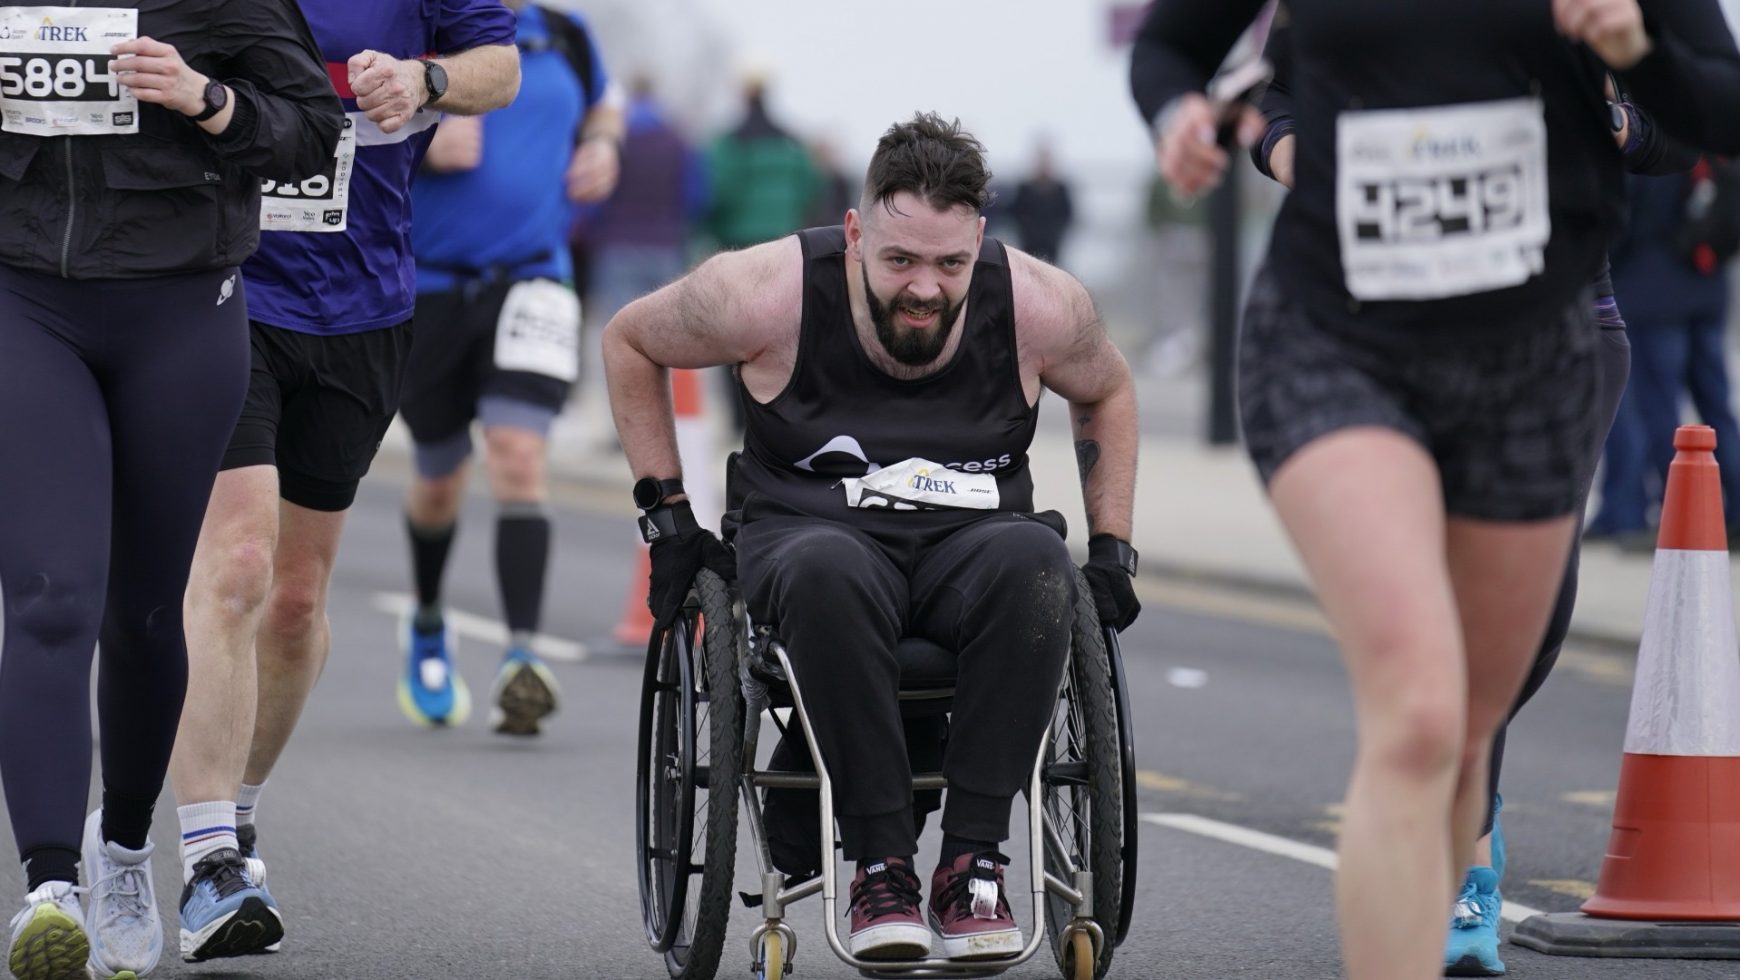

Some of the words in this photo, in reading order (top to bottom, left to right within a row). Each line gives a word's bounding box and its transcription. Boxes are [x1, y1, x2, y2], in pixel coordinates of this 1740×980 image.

[40, 26, 88, 41] TREK
[0, 57, 118, 97] 5884
[1353, 174, 1520, 240] 4249
[945, 453, 1011, 472] cess
[913, 474, 956, 494] TREK
[866, 863, 885, 875] VANS
[977, 859, 994, 870] VANS
